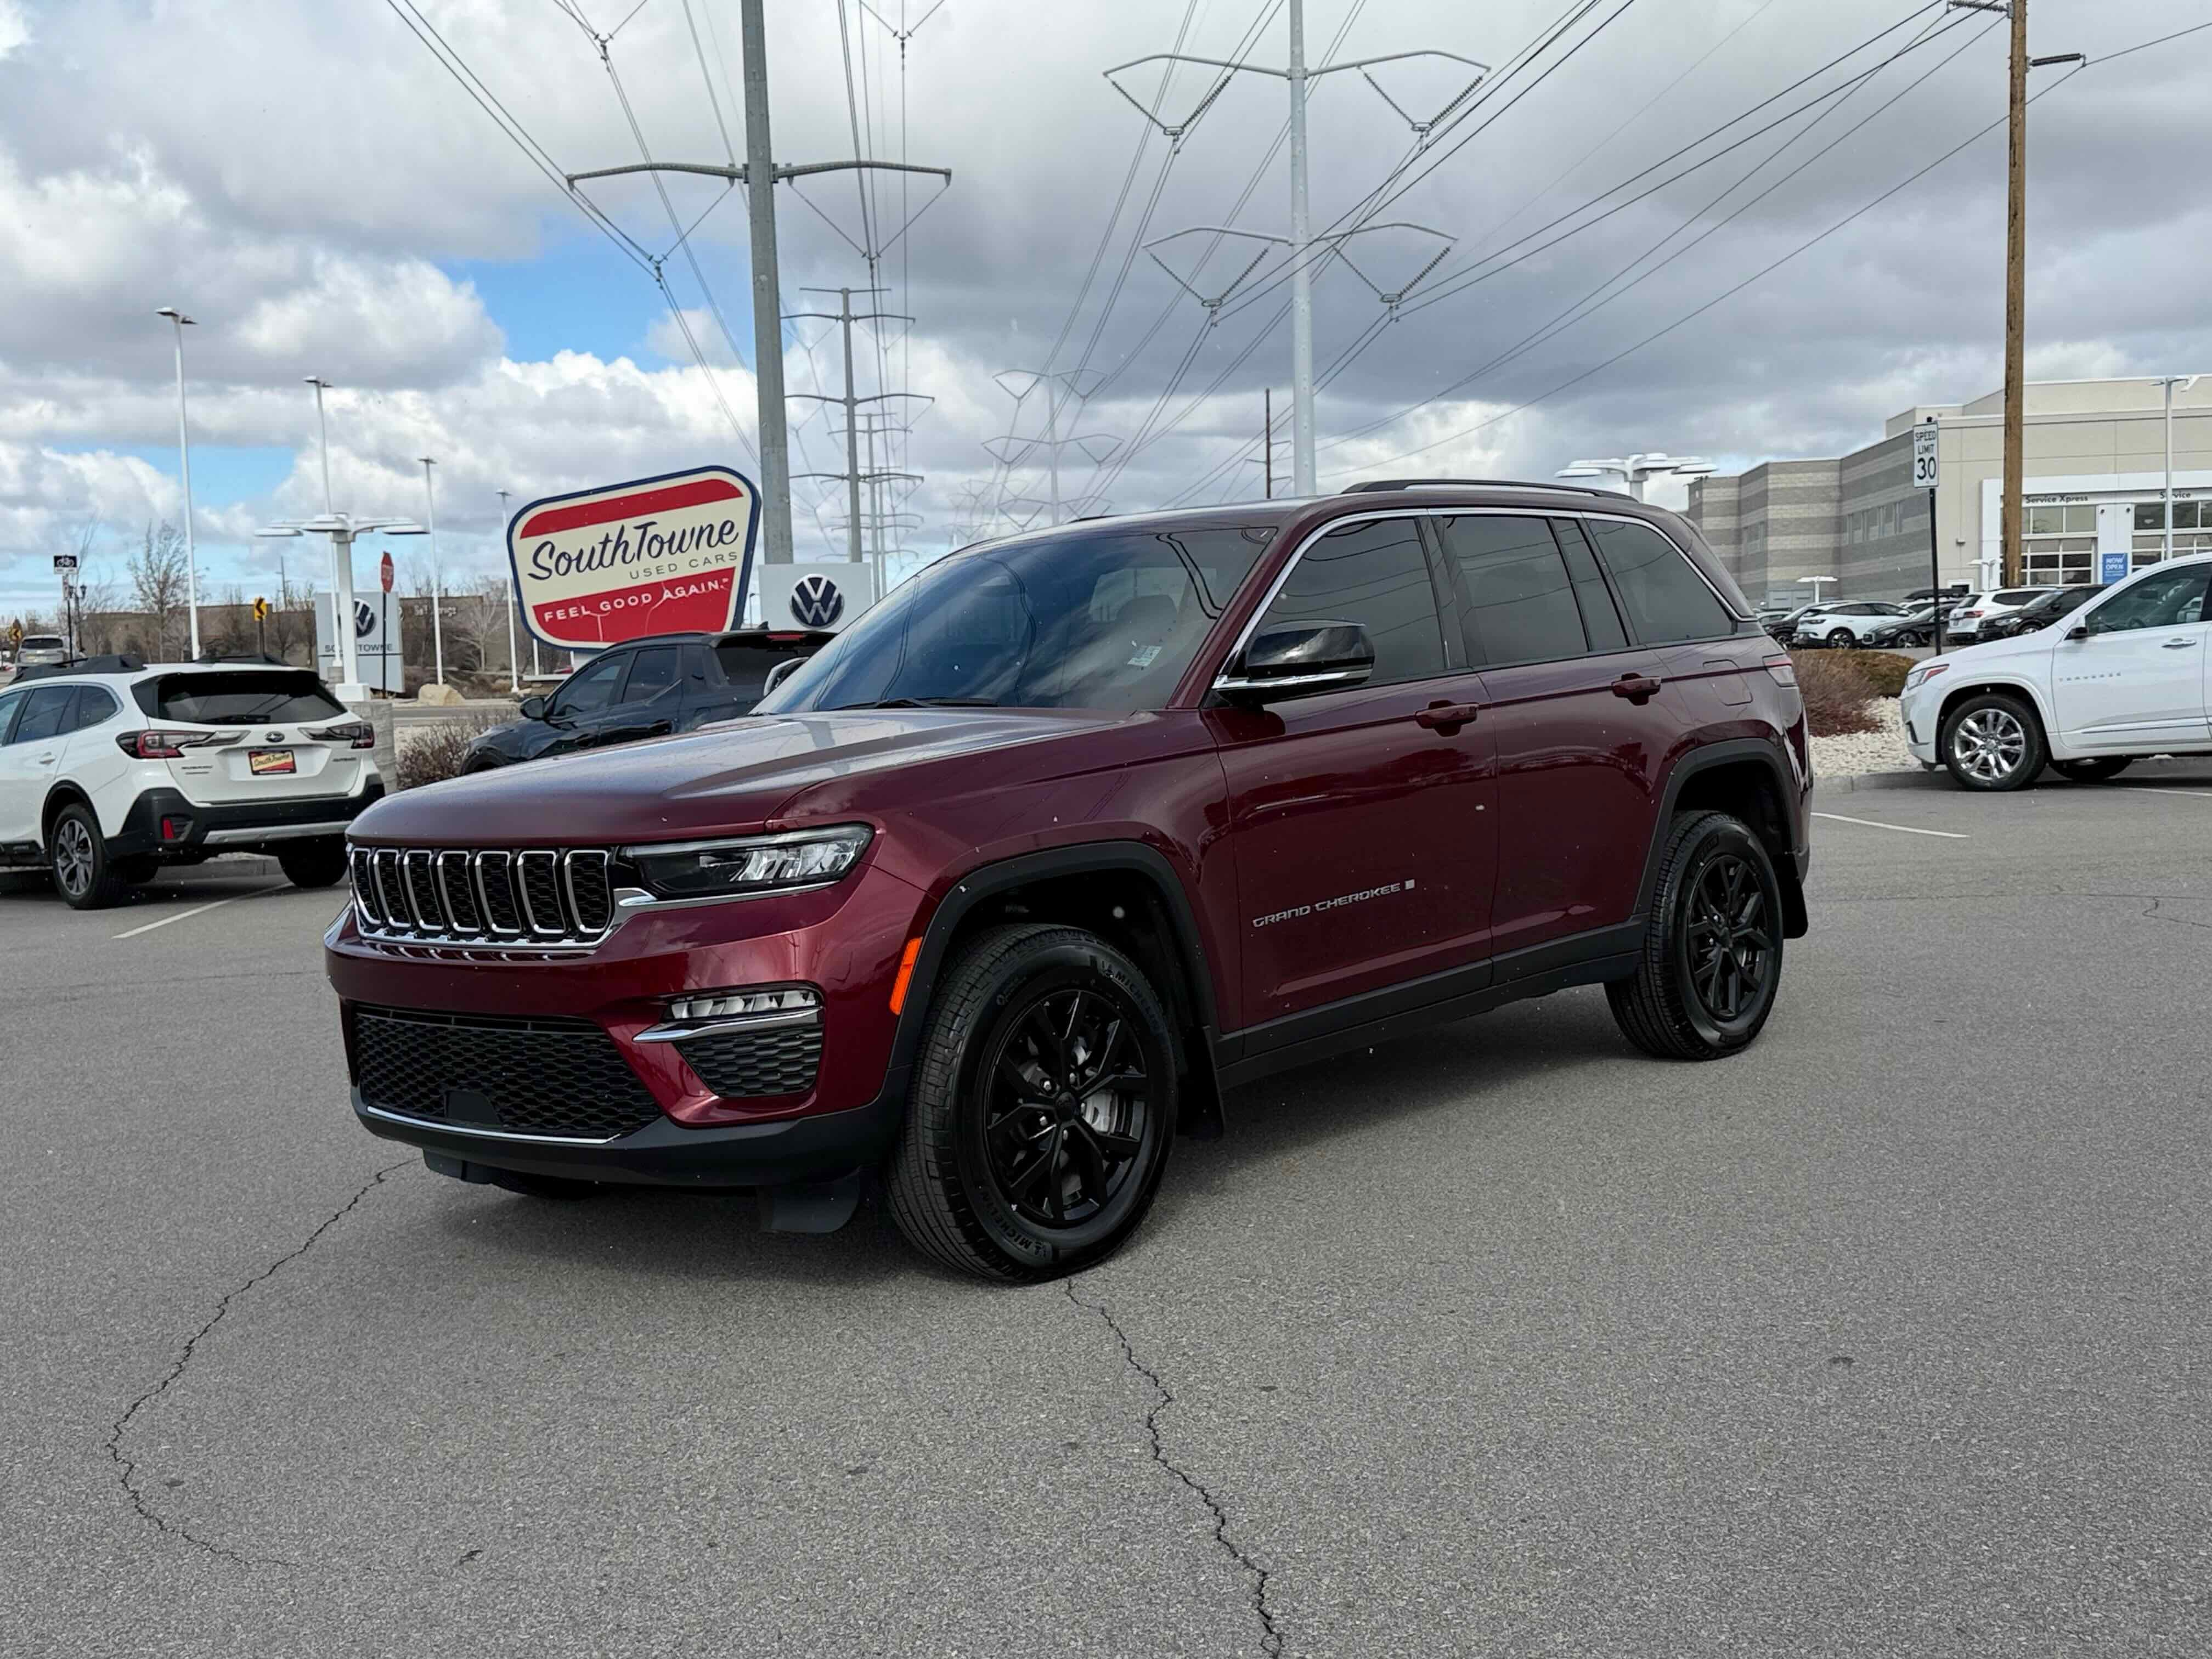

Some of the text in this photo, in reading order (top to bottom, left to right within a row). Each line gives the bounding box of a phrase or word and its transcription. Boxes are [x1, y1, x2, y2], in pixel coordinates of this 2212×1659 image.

[1915, 430, 1936, 442] SPEED
[1918, 444, 1934, 455] LIMIT
[1917, 456, 1936, 480] 30
[2025, 494, 2089, 504] Service Xpress
[2159, 490, 2191, 499] Svice
[527, 520, 739, 580] SouthTowne
[630, 551, 738, 580] USED CARS
[544, 605, 591, 623] FEEL
[599, 592, 652, 612] GOOD
[1252, 883, 1401, 928] GRAND CHEROKEE
